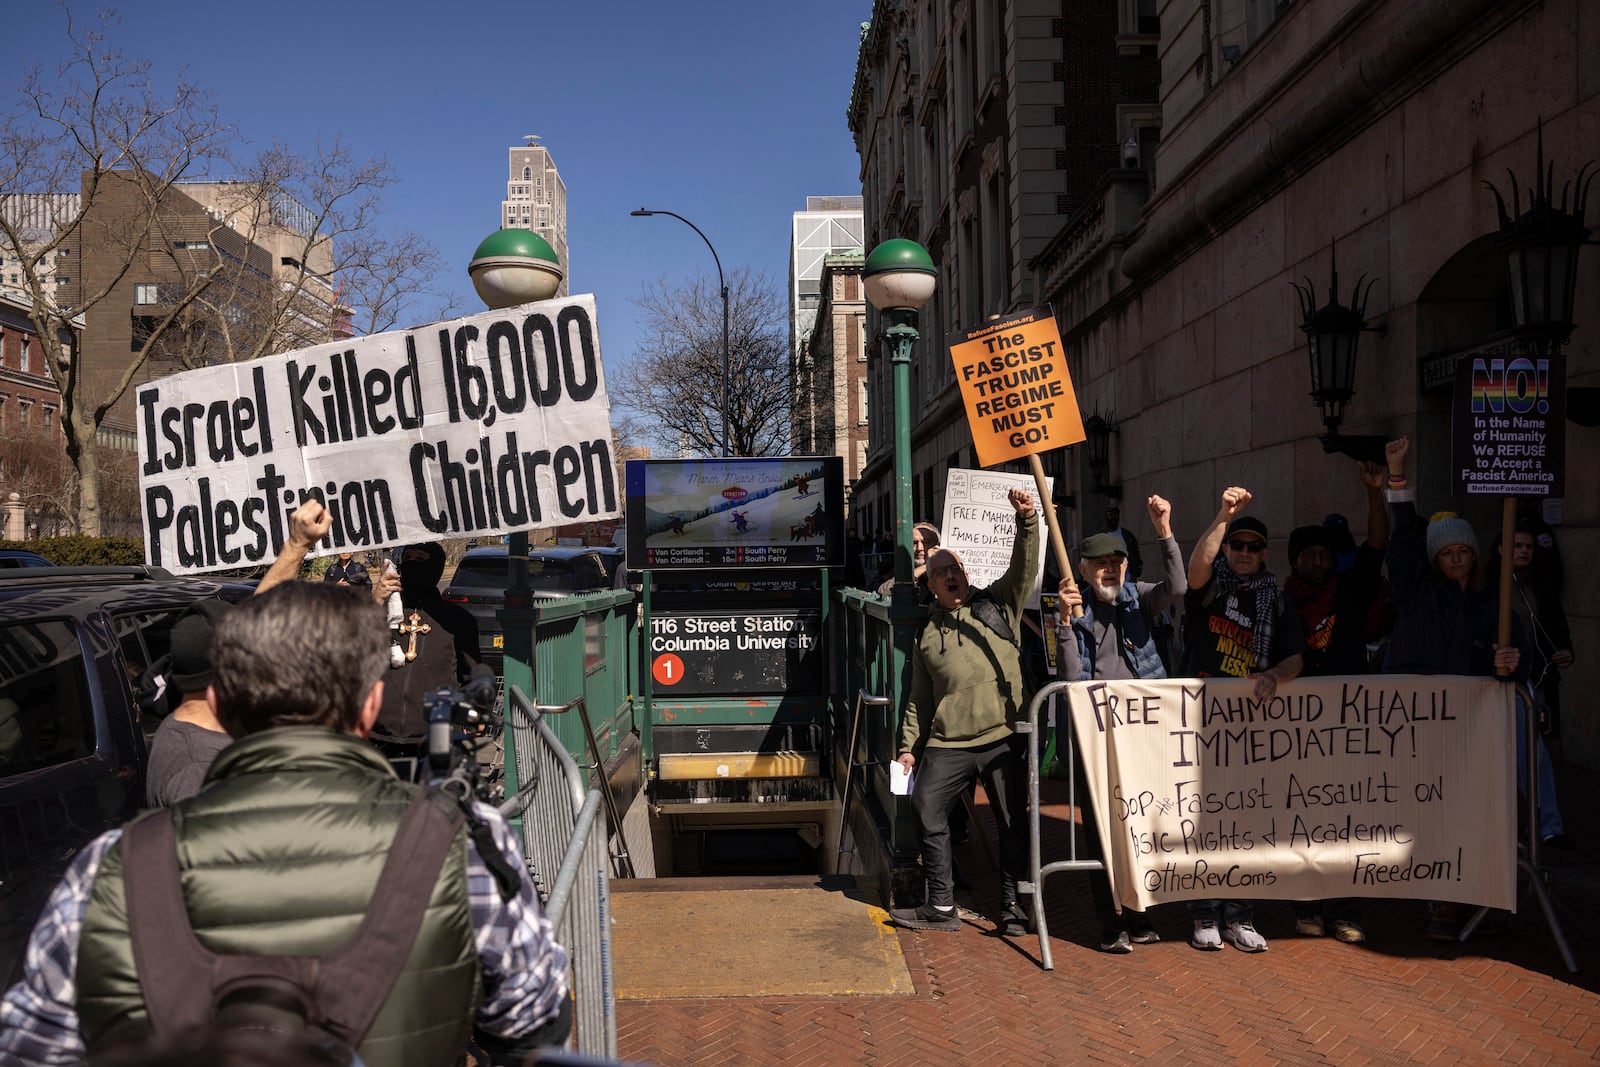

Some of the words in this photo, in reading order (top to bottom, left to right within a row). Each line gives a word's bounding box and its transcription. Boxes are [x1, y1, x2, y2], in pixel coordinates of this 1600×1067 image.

[967, 314, 1035, 339] RefuseFascism.org
[983, 333, 1025, 354] The
[962, 341, 1056, 381] FASCIST
[139, 366, 273, 476] Israel
[287, 335, 425, 447] Killed
[439, 304, 598, 427] 16,000
[974, 363, 1054, 397] TRUMP
[1471, 357, 1550, 414] NO!
[976, 380, 1064, 418] REGIME
[991, 402, 1056, 433] MUST
[1474, 416, 1486, 428] In
[1489, 416, 1510, 428] the
[1513, 417, 1546, 429] Name
[1009, 425, 1049, 448] GO!
[1473, 430, 1486, 441] of
[1489, 430, 1546, 445] Humanity
[1472, 444, 1494, 455] We
[1497, 444, 1546, 456] REFUSE
[1476, 457, 1488, 468] to
[1492, 457, 1533, 471] Accept
[1535, 460, 1542, 469] a
[409, 431, 617, 535] Children
[1461, 469, 1506, 480] Fascist
[1509, 469, 1555, 481] America
[1471, 485, 1547, 493] RefuseFascism.org
[953, 506, 978, 519] FREE
[951, 527, 1015, 547] IMMEDIATE
[655, 548, 668, 556] Van
[670, 548, 704, 556] Cortlandt
[655, 556, 668, 564] Van
[670, 556, 704, 564] Cortlandt
[767, 546, 787, 555] Ferry
[767, 555, 787, 563] Ferry
[651, 618, 677, 634] 116
[685, 617, 737, 633] Street
[744, 617, 805, 633] Station
[651, 635, 730, 652] Columbia
[736, 633, 818, 652] University
[662, 659, 673, 679] 1
[1087, 682, 1161, 732] FREE
[1181, 684, 1324, 728] MAHMOUD
[1340, 683, 1457, 725] KHALIL
[1169, 724, 1417, 768] IMMEDIATELY!
[1175, 778, 1273, 817] Fascist
[1286, 772, 1401, 810] Assault
[1290, 814, 1414, 849] Academic
